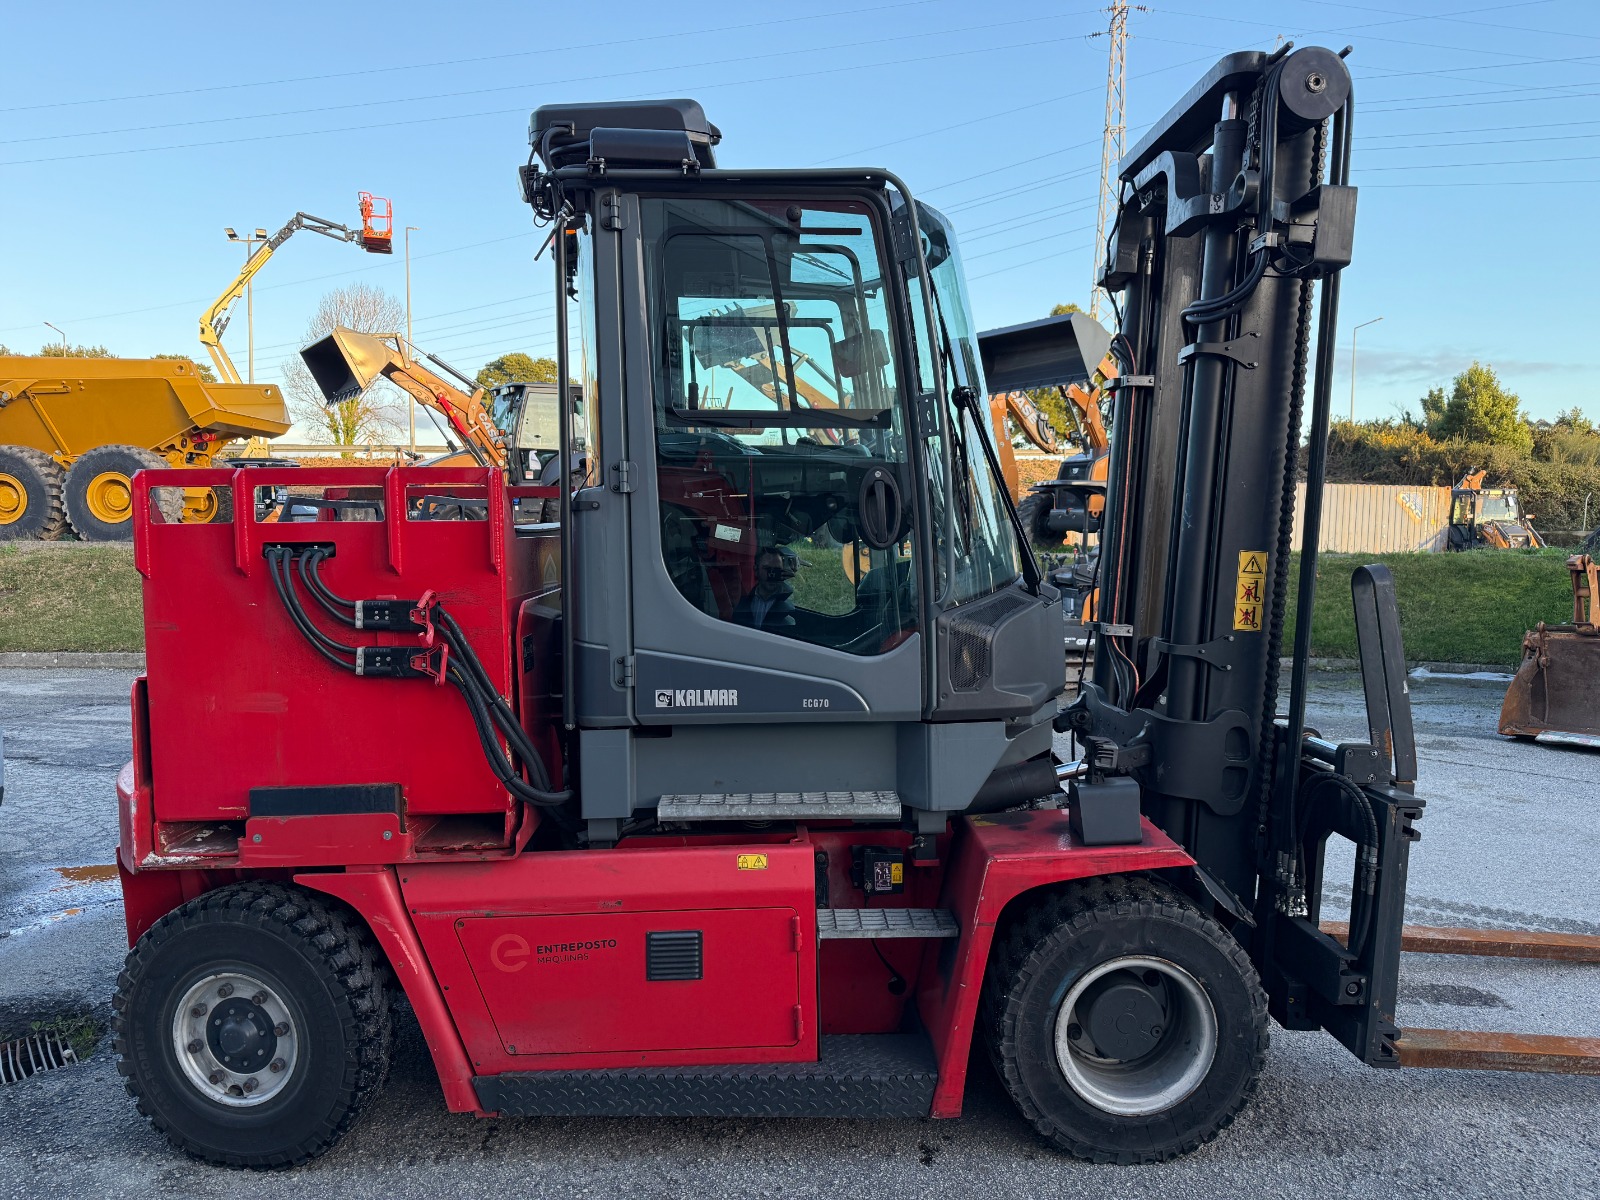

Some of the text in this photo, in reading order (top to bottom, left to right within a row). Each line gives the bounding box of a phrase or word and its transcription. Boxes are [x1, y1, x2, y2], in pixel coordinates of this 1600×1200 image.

[675, 689, 738, 707] KALMAR
[802, 698, 830, 708] ECG70
[536, 939, 617, 954] ENTREPOSTO
